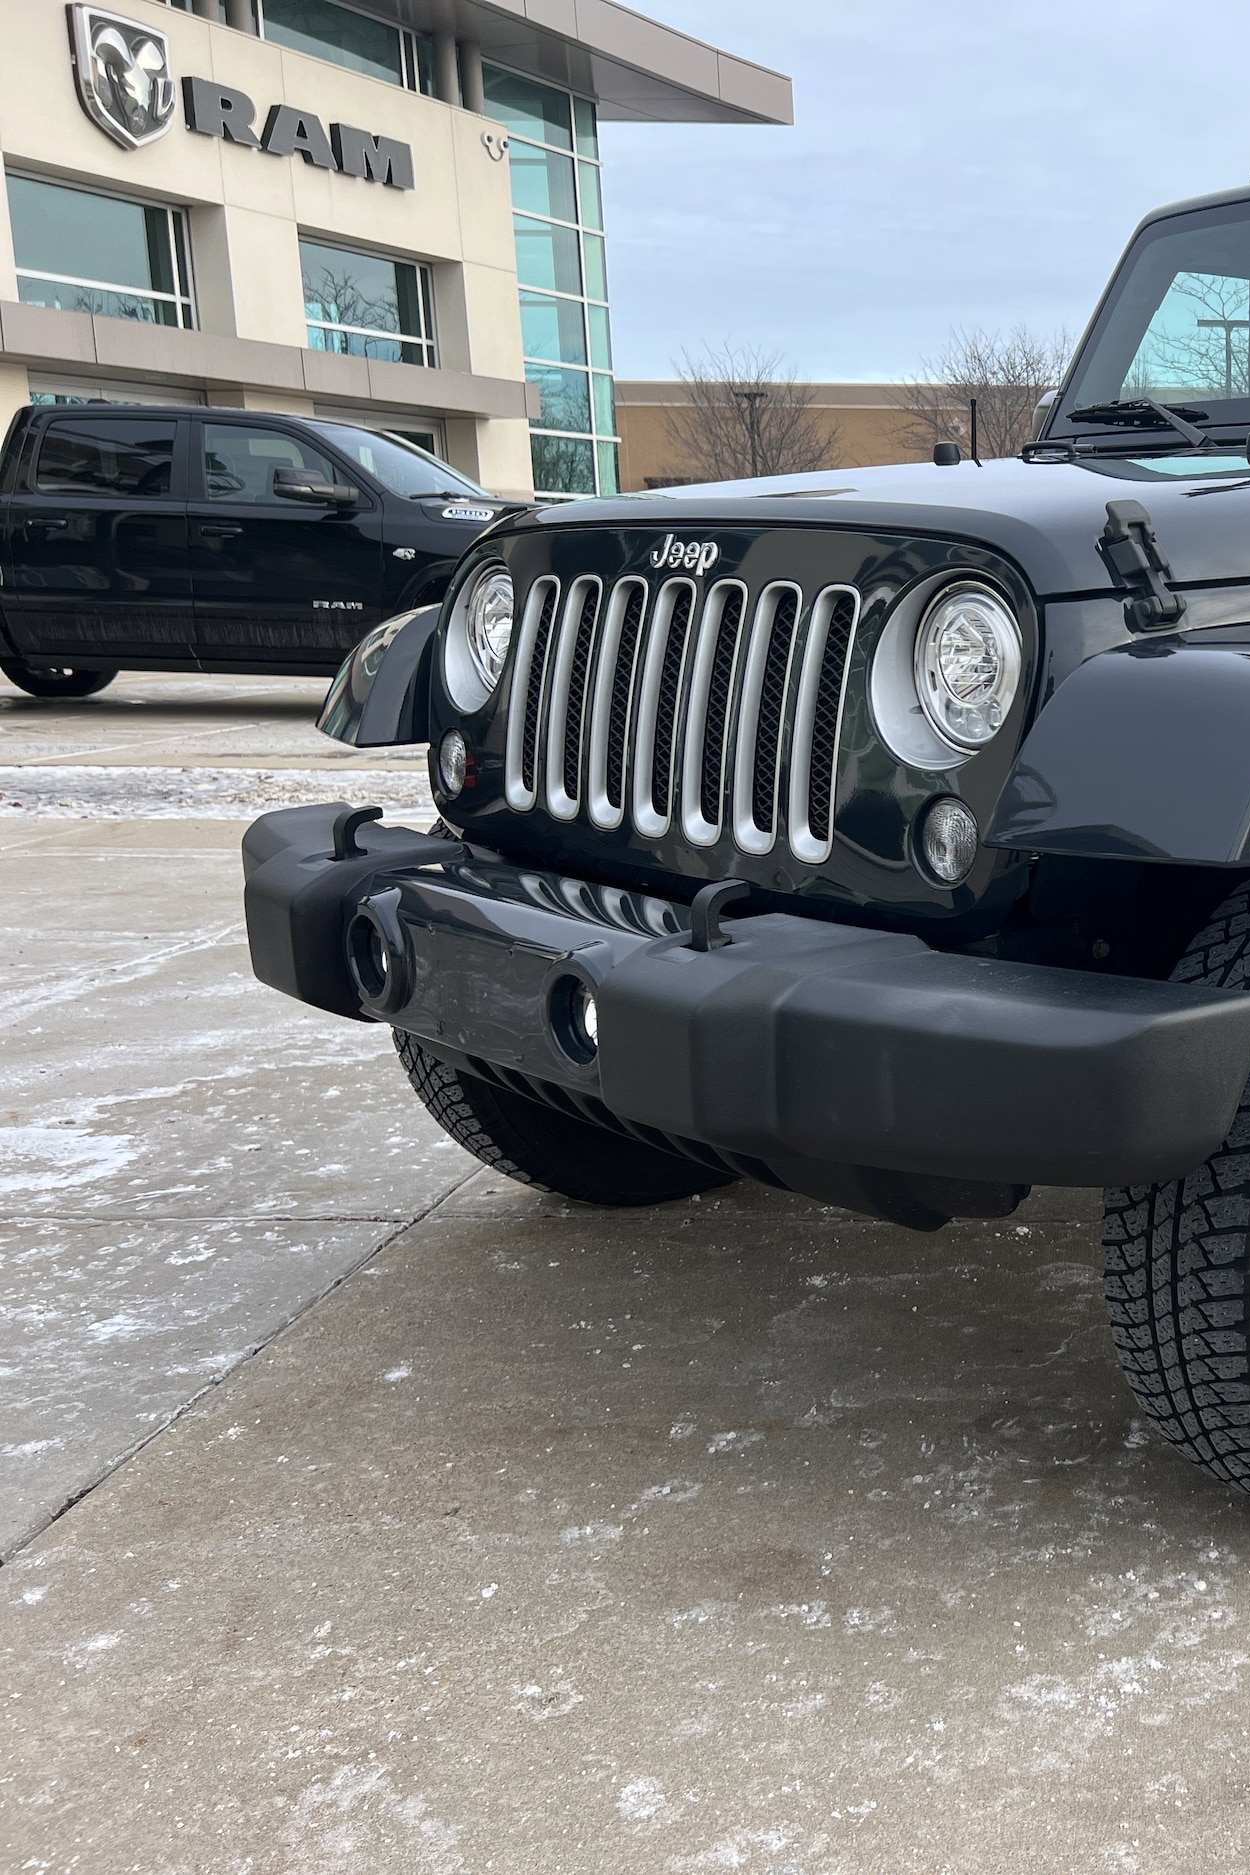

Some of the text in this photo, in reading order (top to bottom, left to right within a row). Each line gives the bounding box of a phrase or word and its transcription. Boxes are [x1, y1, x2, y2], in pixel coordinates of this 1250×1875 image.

[181, 76, 415, 190] RAM
[650, 533, 718, 576] Jeep
[312, 600, 363, 610] RAM
